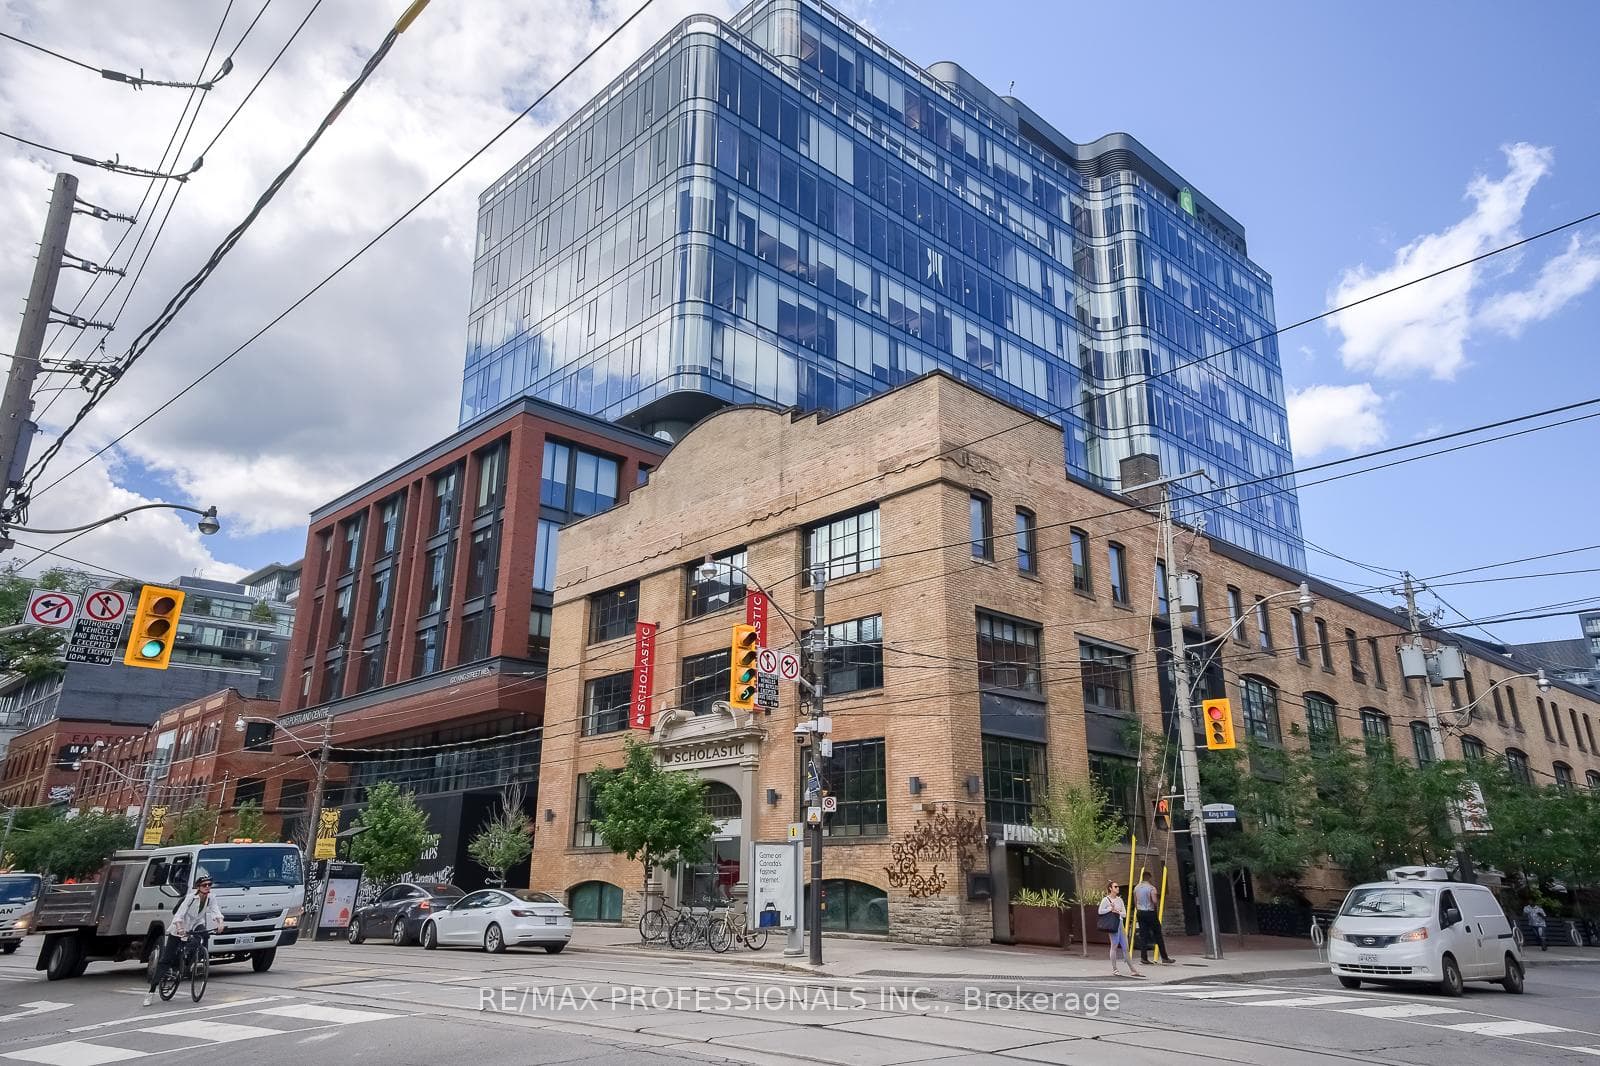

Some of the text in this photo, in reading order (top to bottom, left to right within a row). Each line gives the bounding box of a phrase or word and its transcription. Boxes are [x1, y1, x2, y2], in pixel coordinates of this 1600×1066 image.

[79, 620, 120, 630] AUTHORIZED
[82, 626, 114, 636] VEHICLES
[90, 634, 118, 643] BICYCLES
[77, 639, 111, 648] EXCEPTED
[88, 649, 114, 657] EXCEPTED
[637, 626, 651, 713] SCHOLASTIC
[675, 744, 744, 763] SCHOLASTIC
[759, 851, 774, 859] Game
